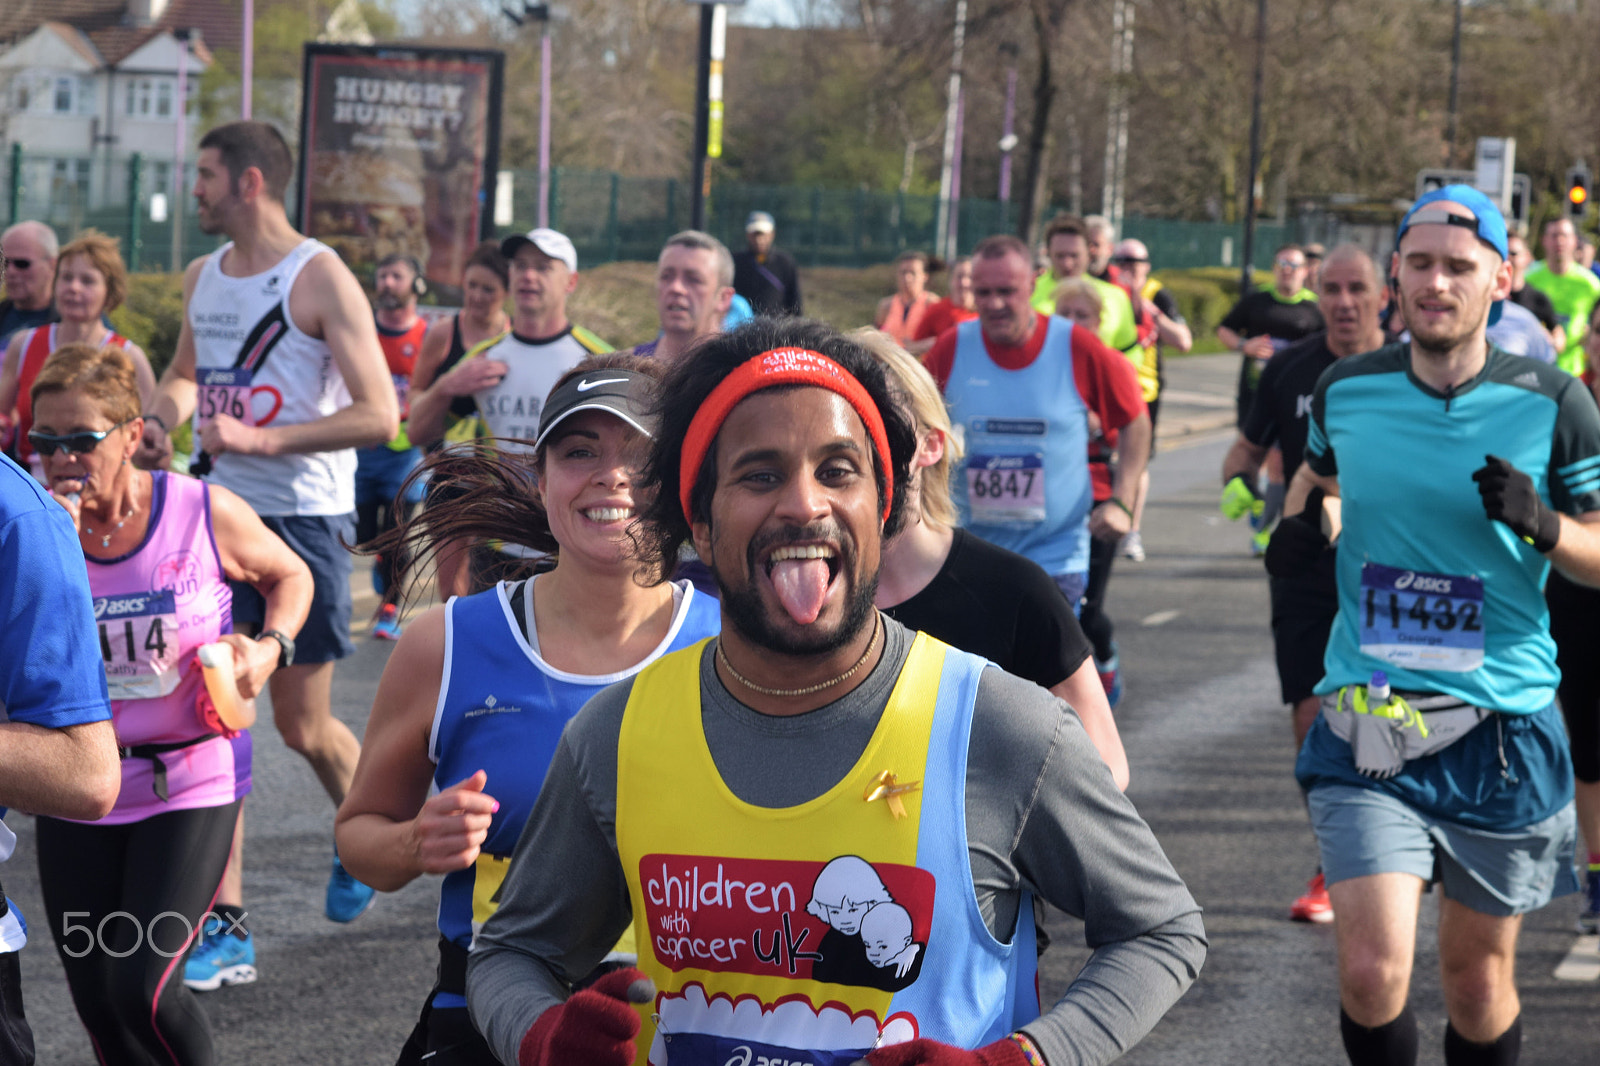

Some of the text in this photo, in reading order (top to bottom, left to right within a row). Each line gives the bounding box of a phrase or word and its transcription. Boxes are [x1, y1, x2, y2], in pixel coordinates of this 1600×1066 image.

[335, 77, 463, 109] HUNGRY
[333, 101, 463, 131] HUNGRY?
[974, 470, 1036, 498] 6847
[1412, 576, 1453, 594] asics
[106, 598, 146, 615] asics
[1366, 589, 1482, 632] 11432
[1397, 632, 1443, 646] George
[105, 663, 138, 675] Cathy
[648, 863, 796, 913] children
[660, 910, 691, 933] with
[656, 911, 824, 974] cancer uk
